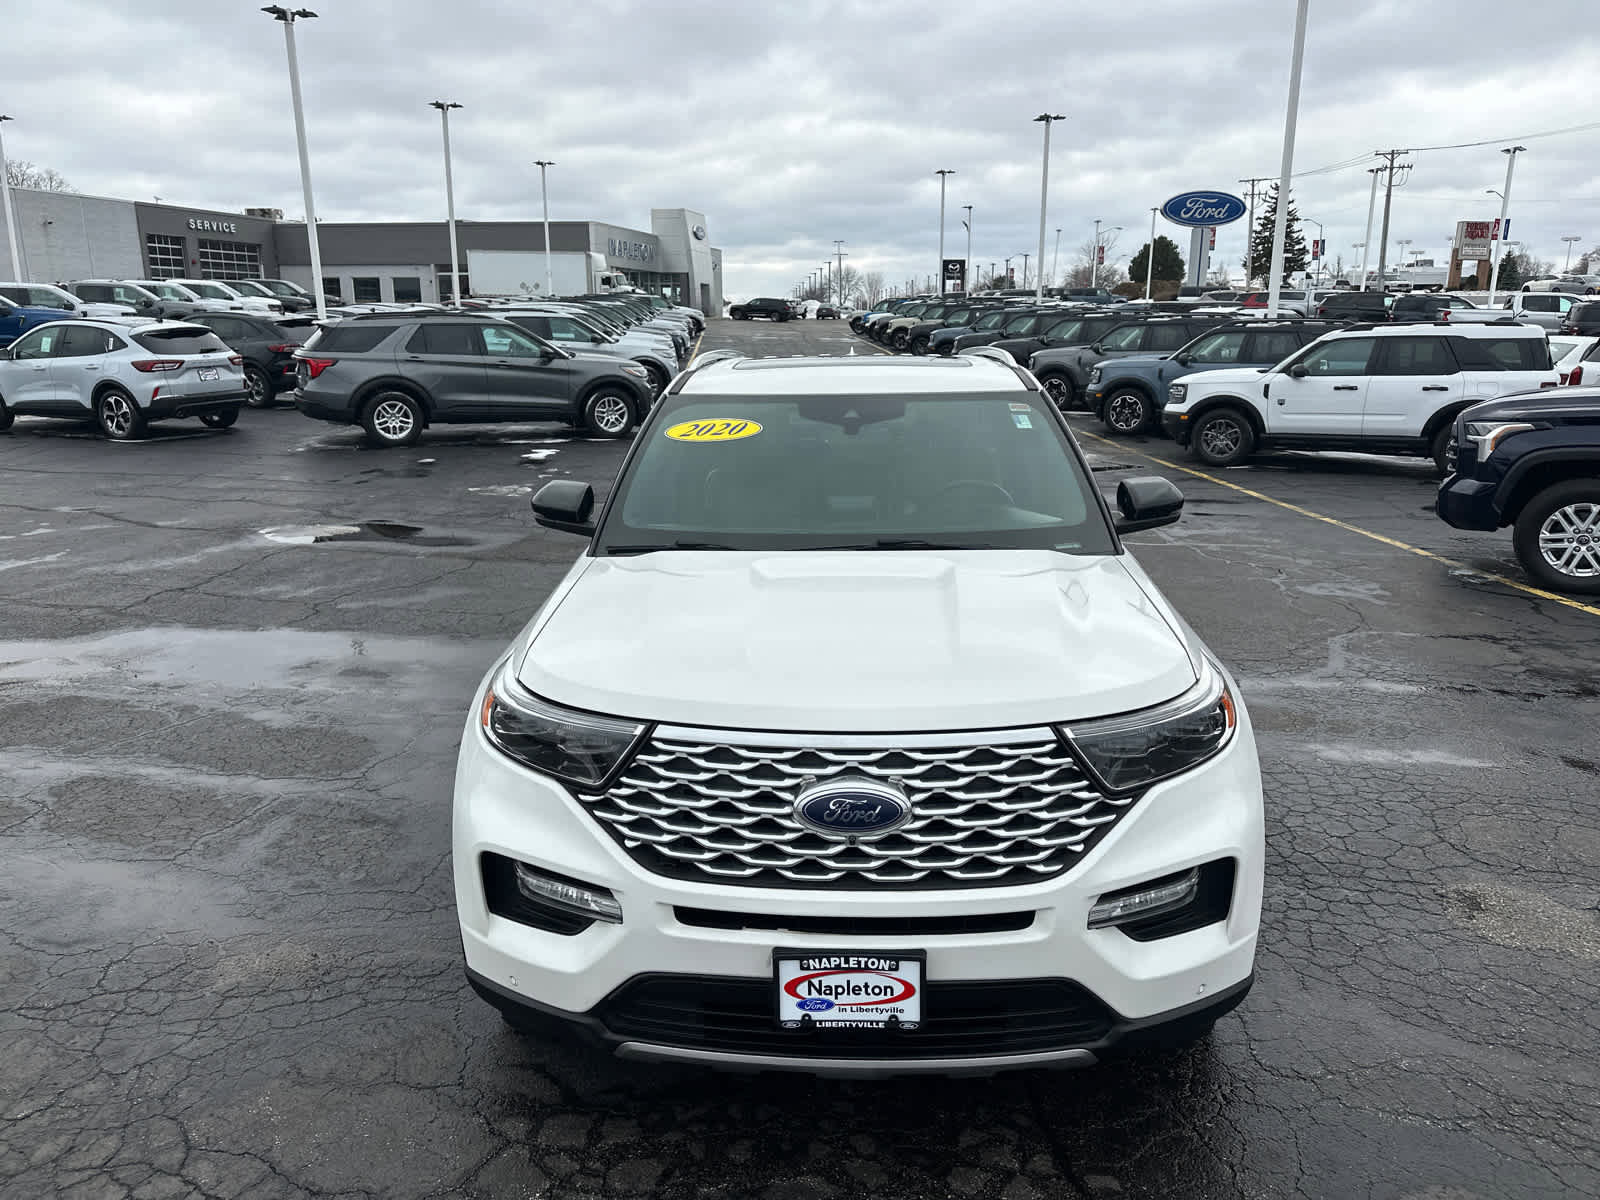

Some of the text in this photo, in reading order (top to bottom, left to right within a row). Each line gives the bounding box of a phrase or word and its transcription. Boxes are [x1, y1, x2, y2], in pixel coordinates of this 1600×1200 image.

[1181, 198, 1230, 218] Ford
[189, 219, 236, 233] SERVICE
[680, 423, 748, 437] 2020
[824, 798, 882, 822] Ford
[809, 957, 890, 970] NAPLETON
[807, 979, 894, 999] Napleton
[804, 999, 828, 1010] Ford
[850, 1006, 905, 1014] Libertyville
[816, 1021, 885, 1029] LIBERTYVILLE
